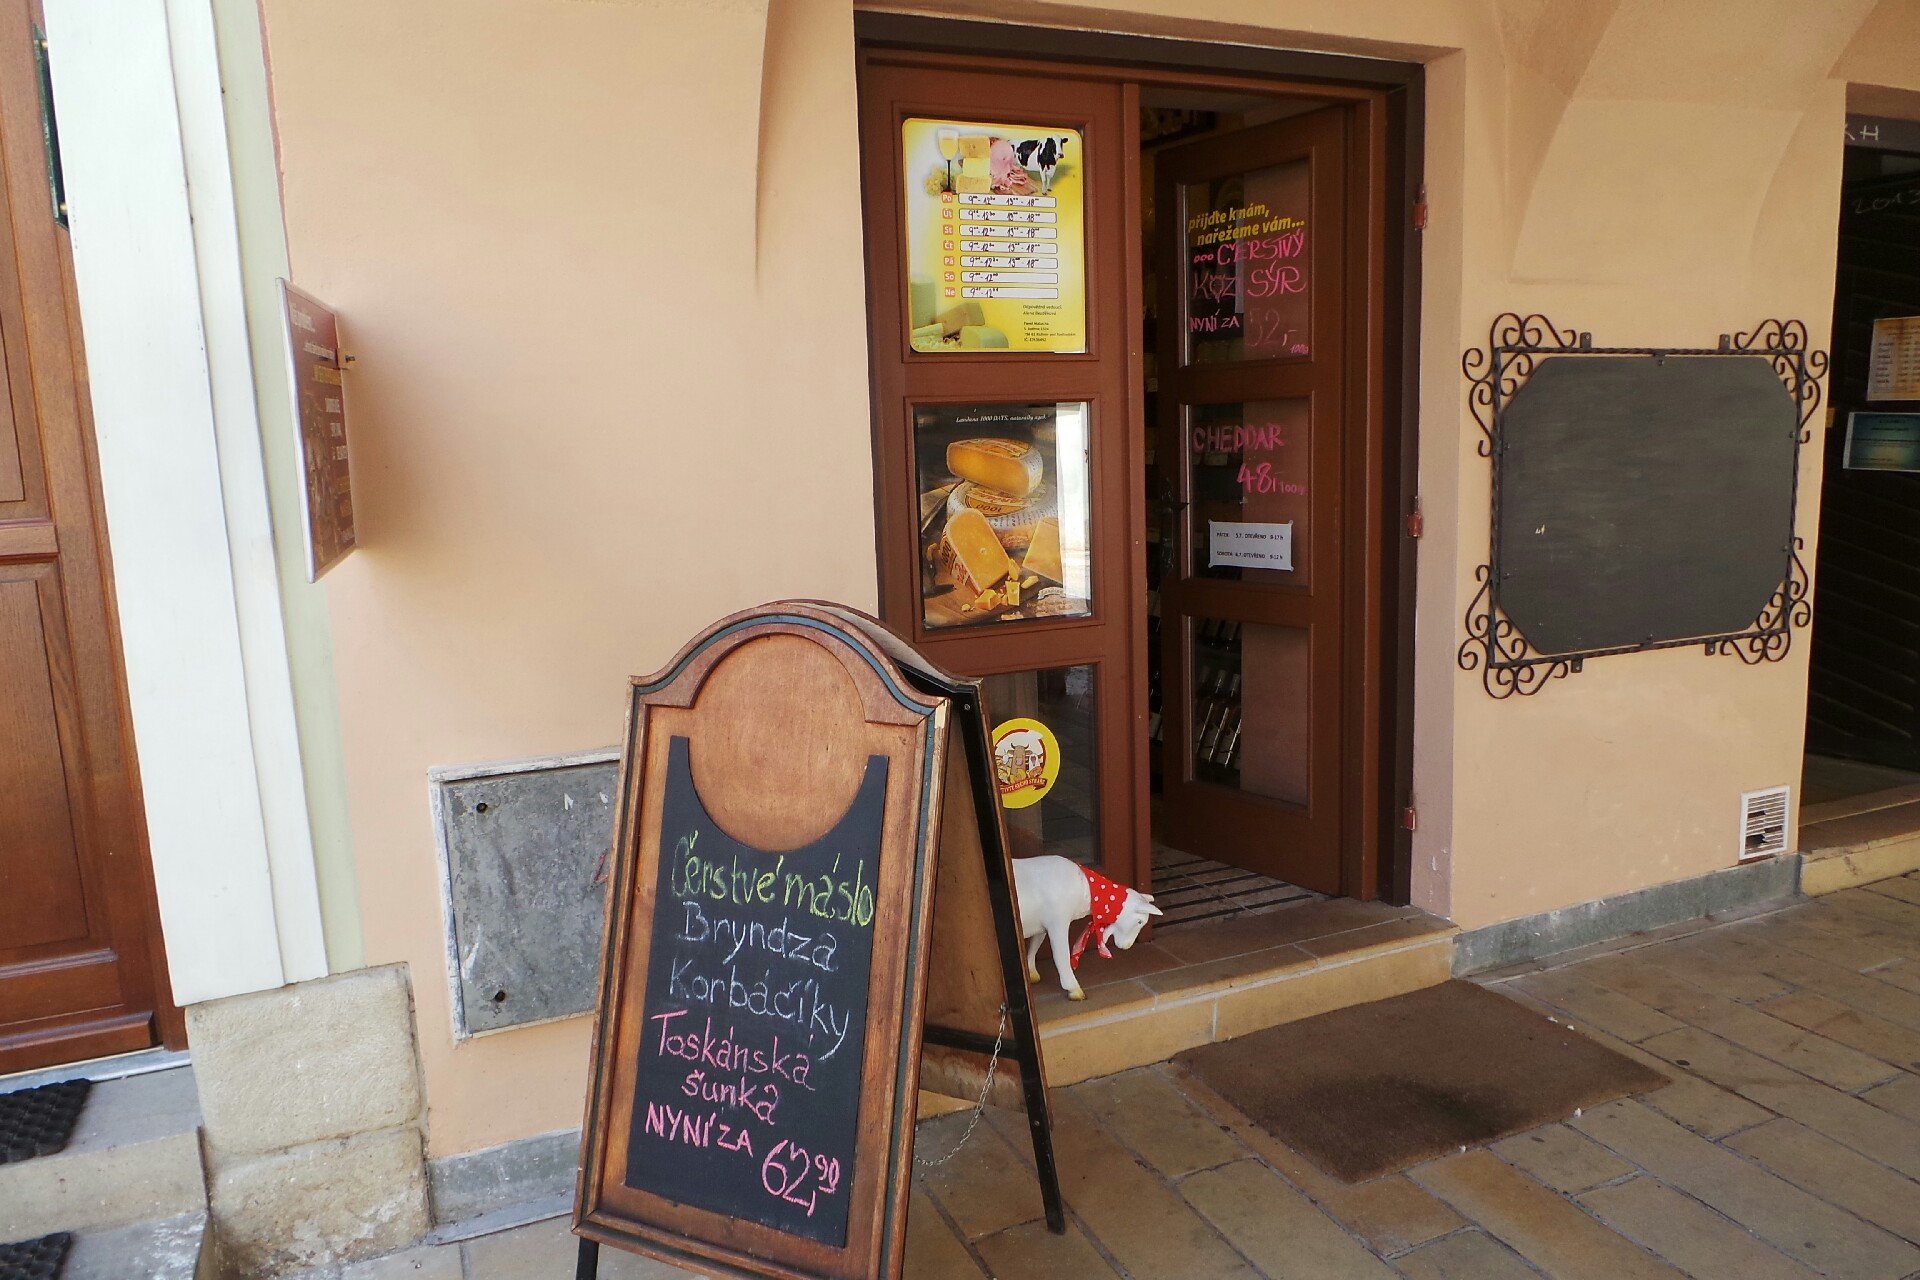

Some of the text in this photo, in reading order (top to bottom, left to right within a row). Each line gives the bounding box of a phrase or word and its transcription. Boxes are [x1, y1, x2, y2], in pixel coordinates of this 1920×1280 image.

[943, 194, 952, 202] Po
[943, 208, 953, 218] Út
[1238, 203, 1270, 219] nám,
[944, 226, 953, 234] St
[1197, 216, 1305, 246] nařežeme vám...
[944, 240, 954, 249] Čt
[945, 273, 955, 281] So
[1247, 259, 1307, 298] SÝR
[1220, 315, 1241, 329] ZA
[1193, 422, 1285, 453] CHEDDAR
[671, 830, 875, 928] Čerstvé máslo
[676, 901, 839, 973] Bryndza
[669, 958, 851, 1061] Korbáčíky
[645, 1100, 717, 1148] NYNÍ
[717, 1124, 754, 1159] ZA
